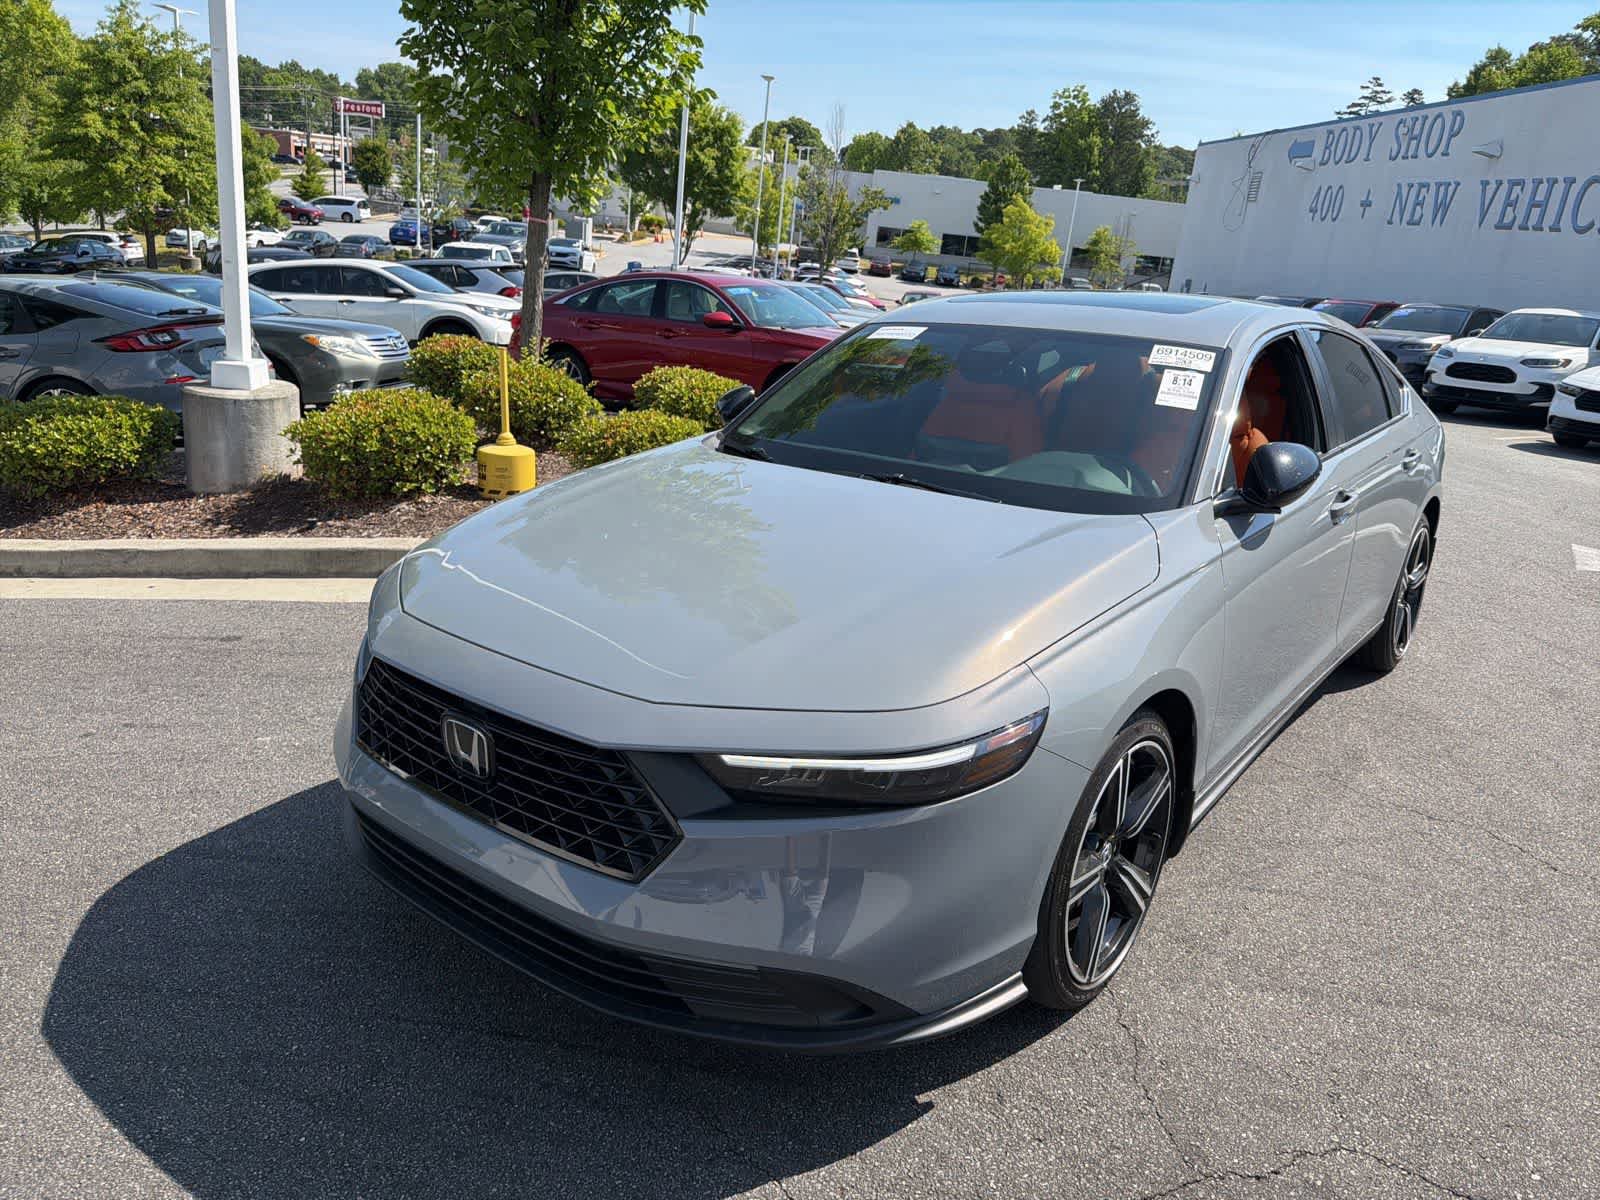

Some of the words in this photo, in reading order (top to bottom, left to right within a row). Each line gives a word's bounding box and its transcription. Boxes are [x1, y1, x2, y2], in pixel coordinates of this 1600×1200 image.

[336, 101, 382, 114] Frestone
[1319, 121, 1383, 166] BODY
[1388, 109, 1465, 161] SHOP
[1309, 184, 1344, 222] 400
[1360, 188, 1372, 219] +
[1387, 180, 1461, 227] NEW
[1479, 175, 1600, 235] VEHIC
[1156, 347, 1212, 361] 6914509
